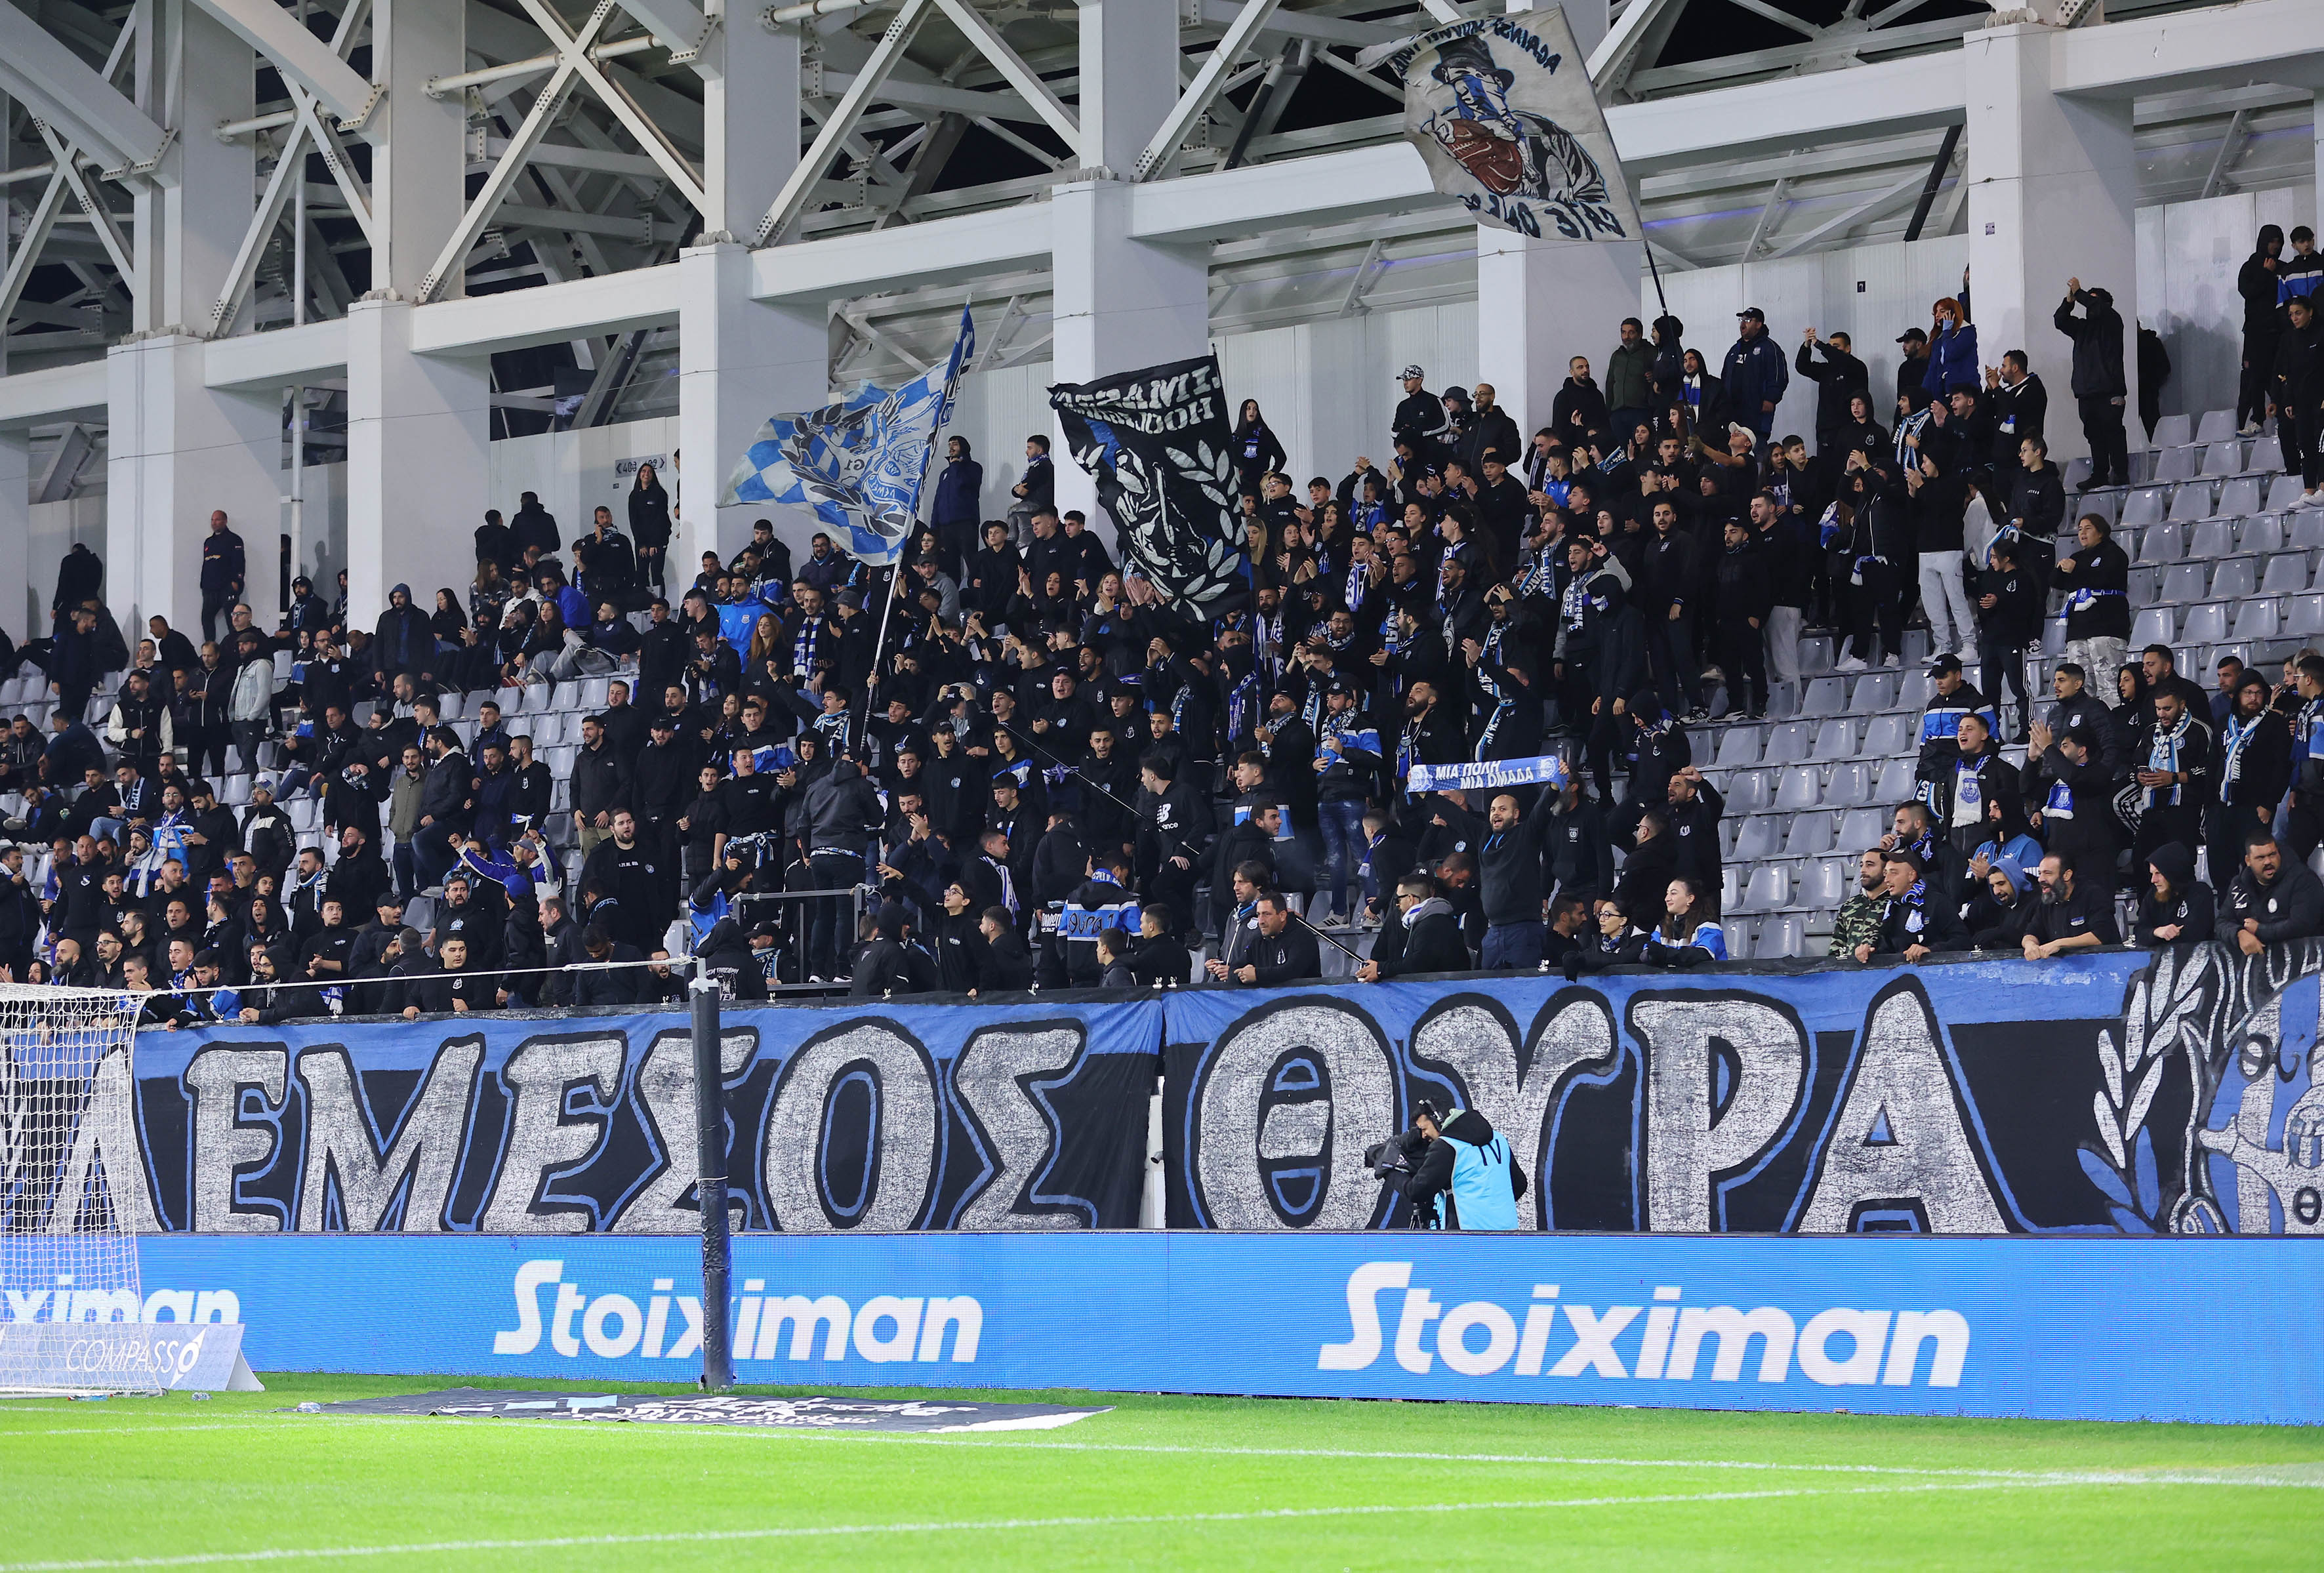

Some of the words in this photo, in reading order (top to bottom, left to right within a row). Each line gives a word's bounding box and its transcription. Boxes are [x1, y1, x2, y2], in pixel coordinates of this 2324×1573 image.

[1435, 764, 1459, 781] ΜΙΑ
[1460, 774, 1484, 790] ΜΙΑ
[1198, 991, 2010, 1234] ΘΥΡΑ
[0, 1275, 240, 1323] ximan
[493, 1259, 983, 1362] Stoiximan
[1317, 1261, 1970, 1387] Stoiximan
[66, 1339, 201, 1374] COMPASSO
